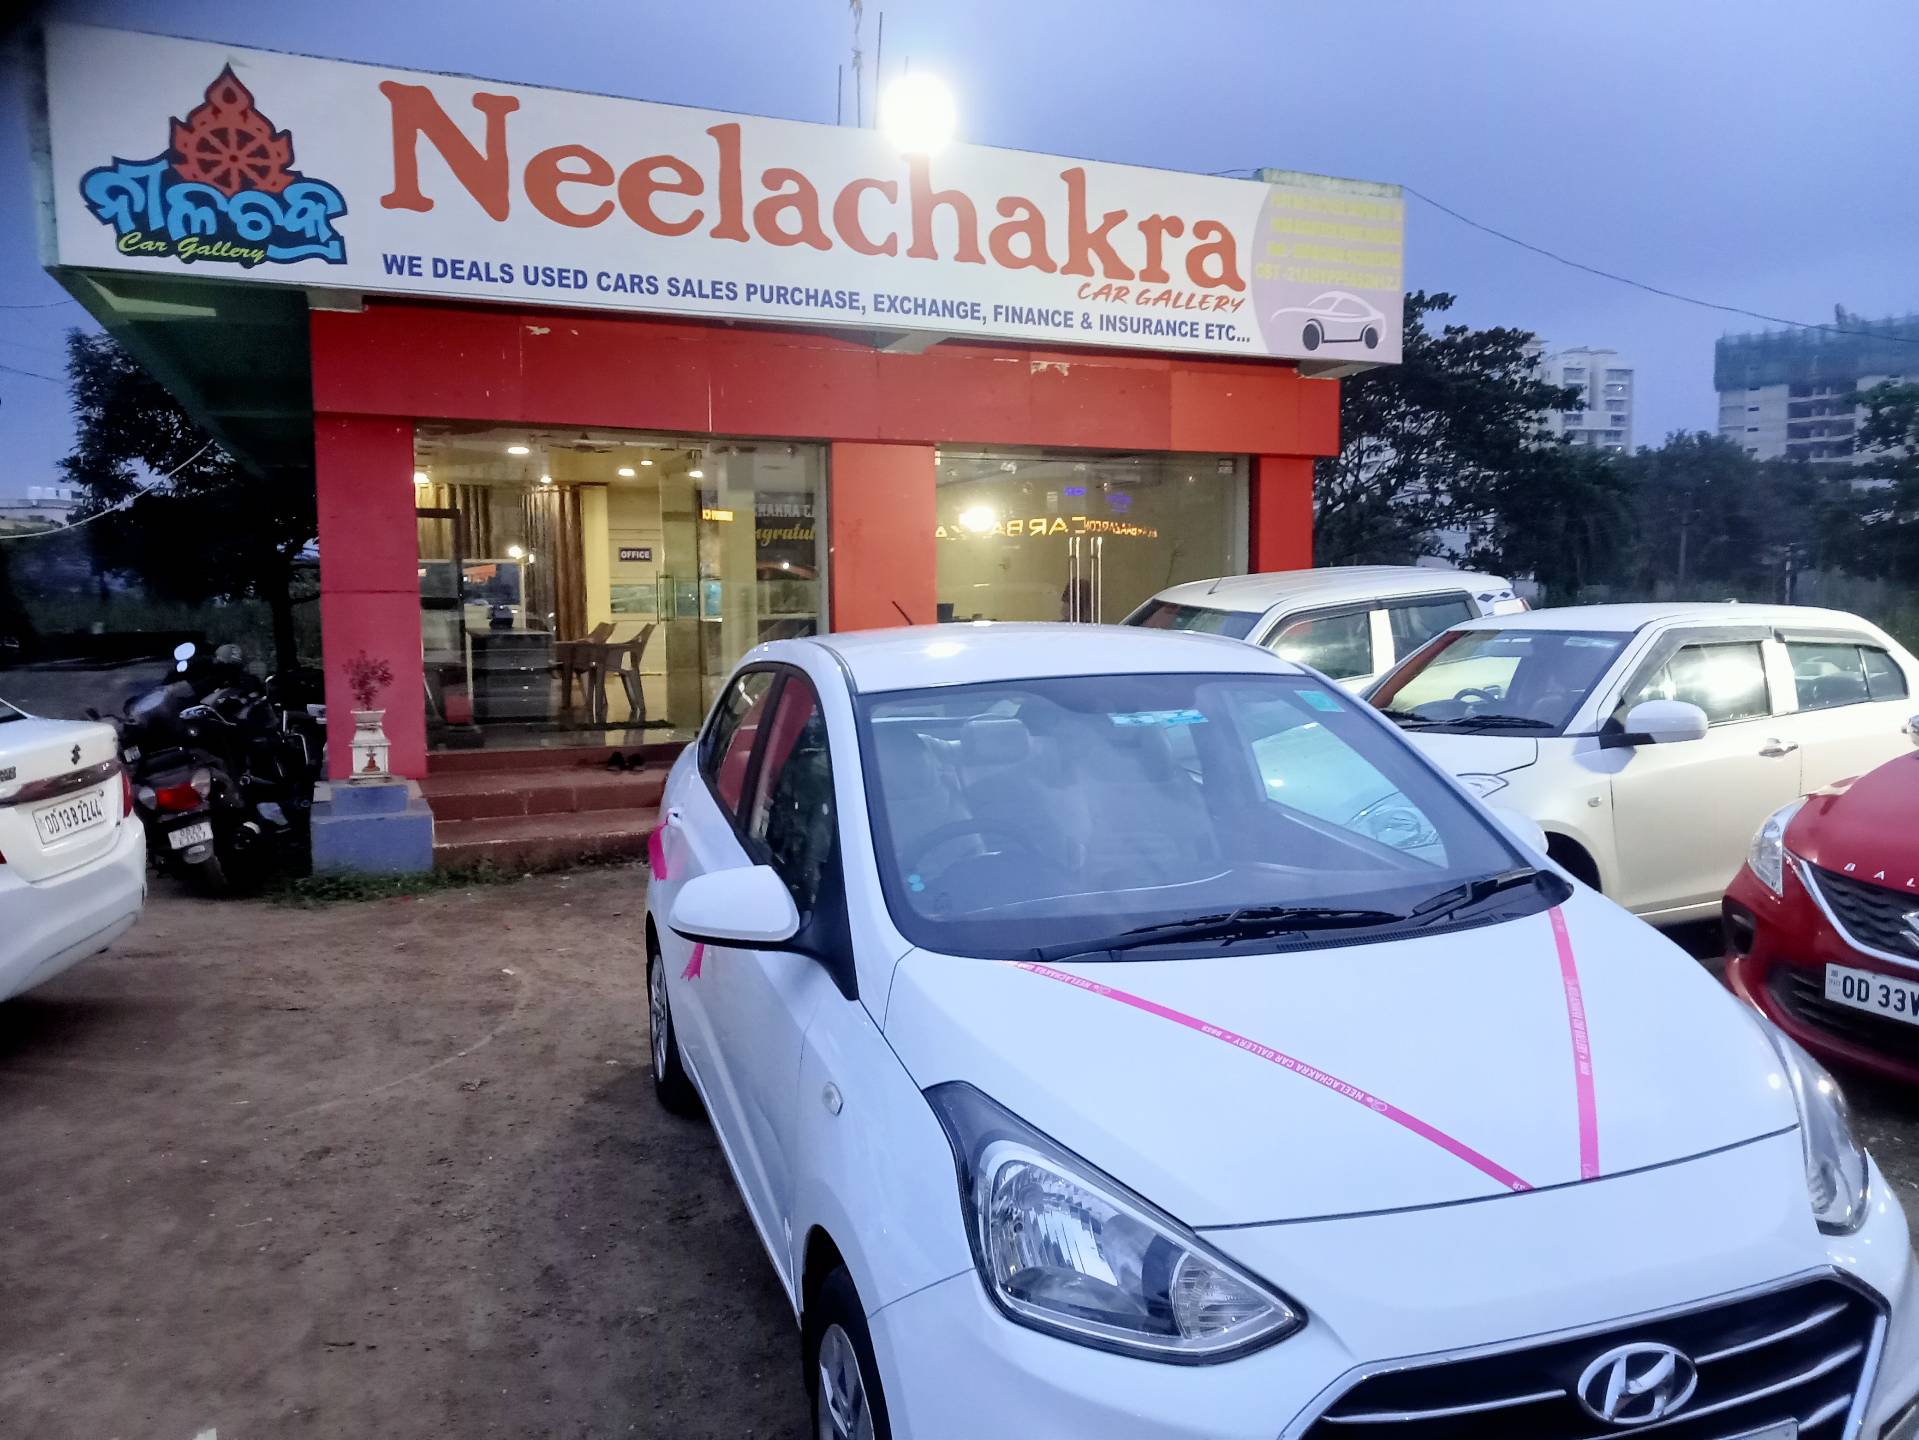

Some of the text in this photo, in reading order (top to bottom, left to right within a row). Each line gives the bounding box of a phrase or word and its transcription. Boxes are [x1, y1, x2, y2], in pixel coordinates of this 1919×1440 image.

[378, 80, 1246, 292] Neelachakra
[118, 231, 266, 262] Car Gallery
[382, 253, 1251, 343] WE DEALS USED CARS SALES PURCHASE, EXCHANGE, FINANCE & INSURANCE ETC...
[1077, 282, 1246, 313] CAR GALLERY
[621, 550, 650, 559] OFFICE
[1274, 1053, 1296, 1069] CAR
